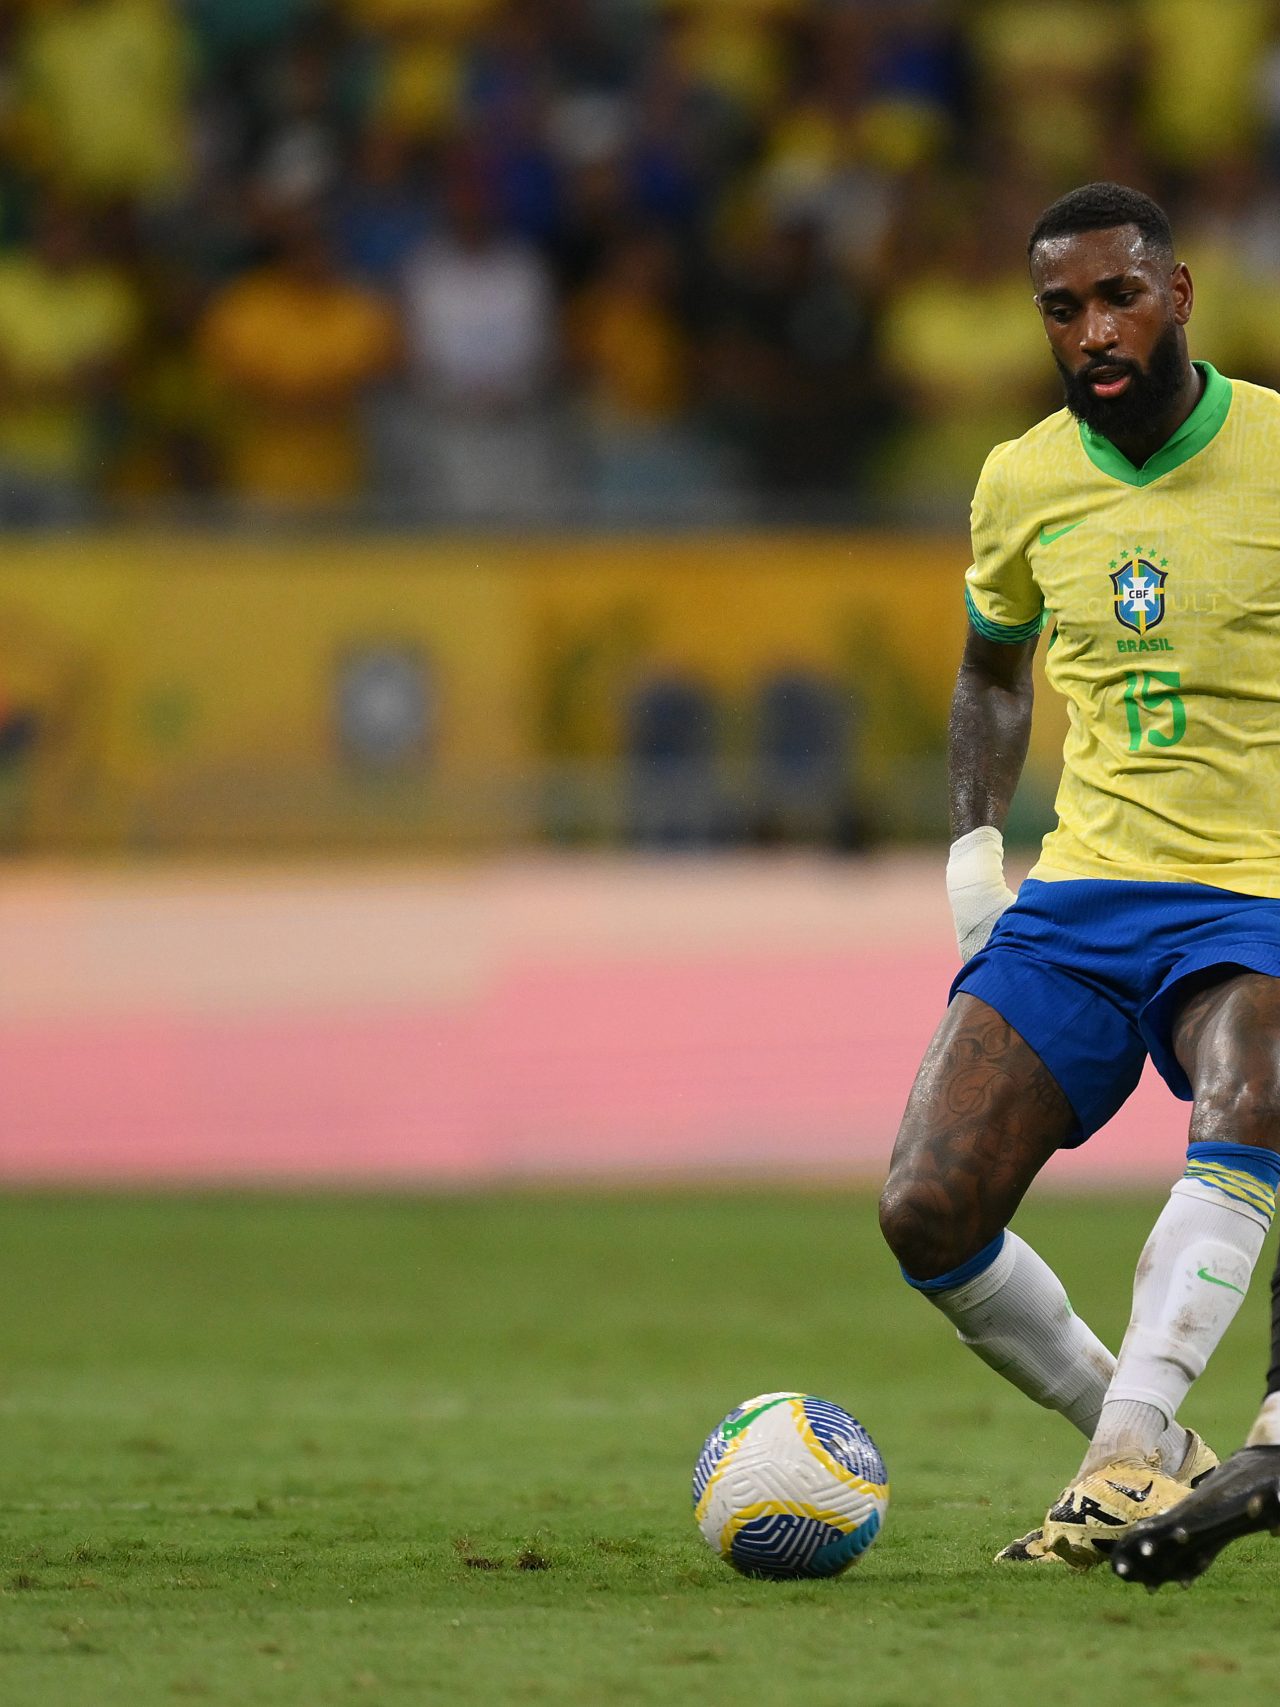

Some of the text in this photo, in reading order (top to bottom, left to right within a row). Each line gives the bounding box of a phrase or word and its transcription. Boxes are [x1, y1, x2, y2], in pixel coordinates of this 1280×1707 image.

[1128, 590, 1150, 599] CBF
[1117, 638, 1174, 653] BRASIL
[1123, 671, 1187, 751] 15
